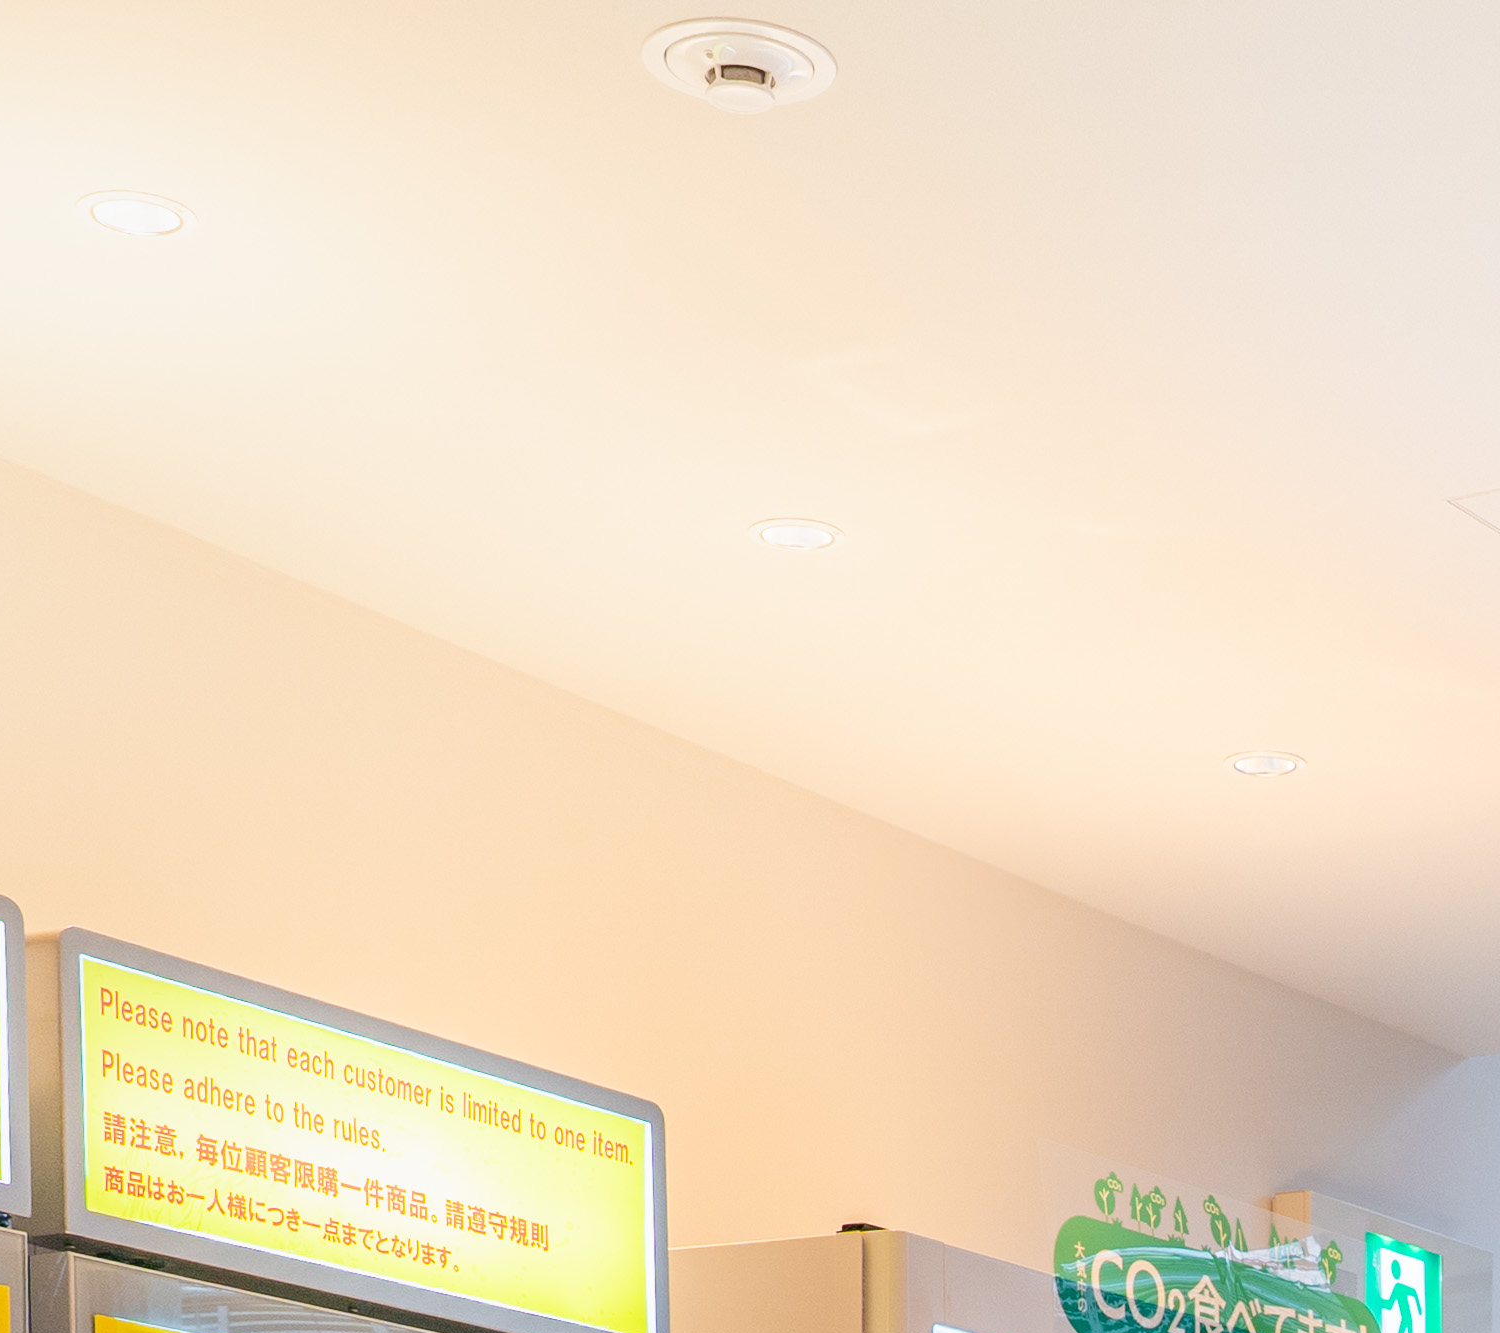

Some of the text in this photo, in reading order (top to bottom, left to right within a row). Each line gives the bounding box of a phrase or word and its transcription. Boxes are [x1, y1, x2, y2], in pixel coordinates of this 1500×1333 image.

[100, 987, 633, 1166] Please note that each customer is limited to one item.
[101, 1050, 386, 1153] Please adhere to the rules.
